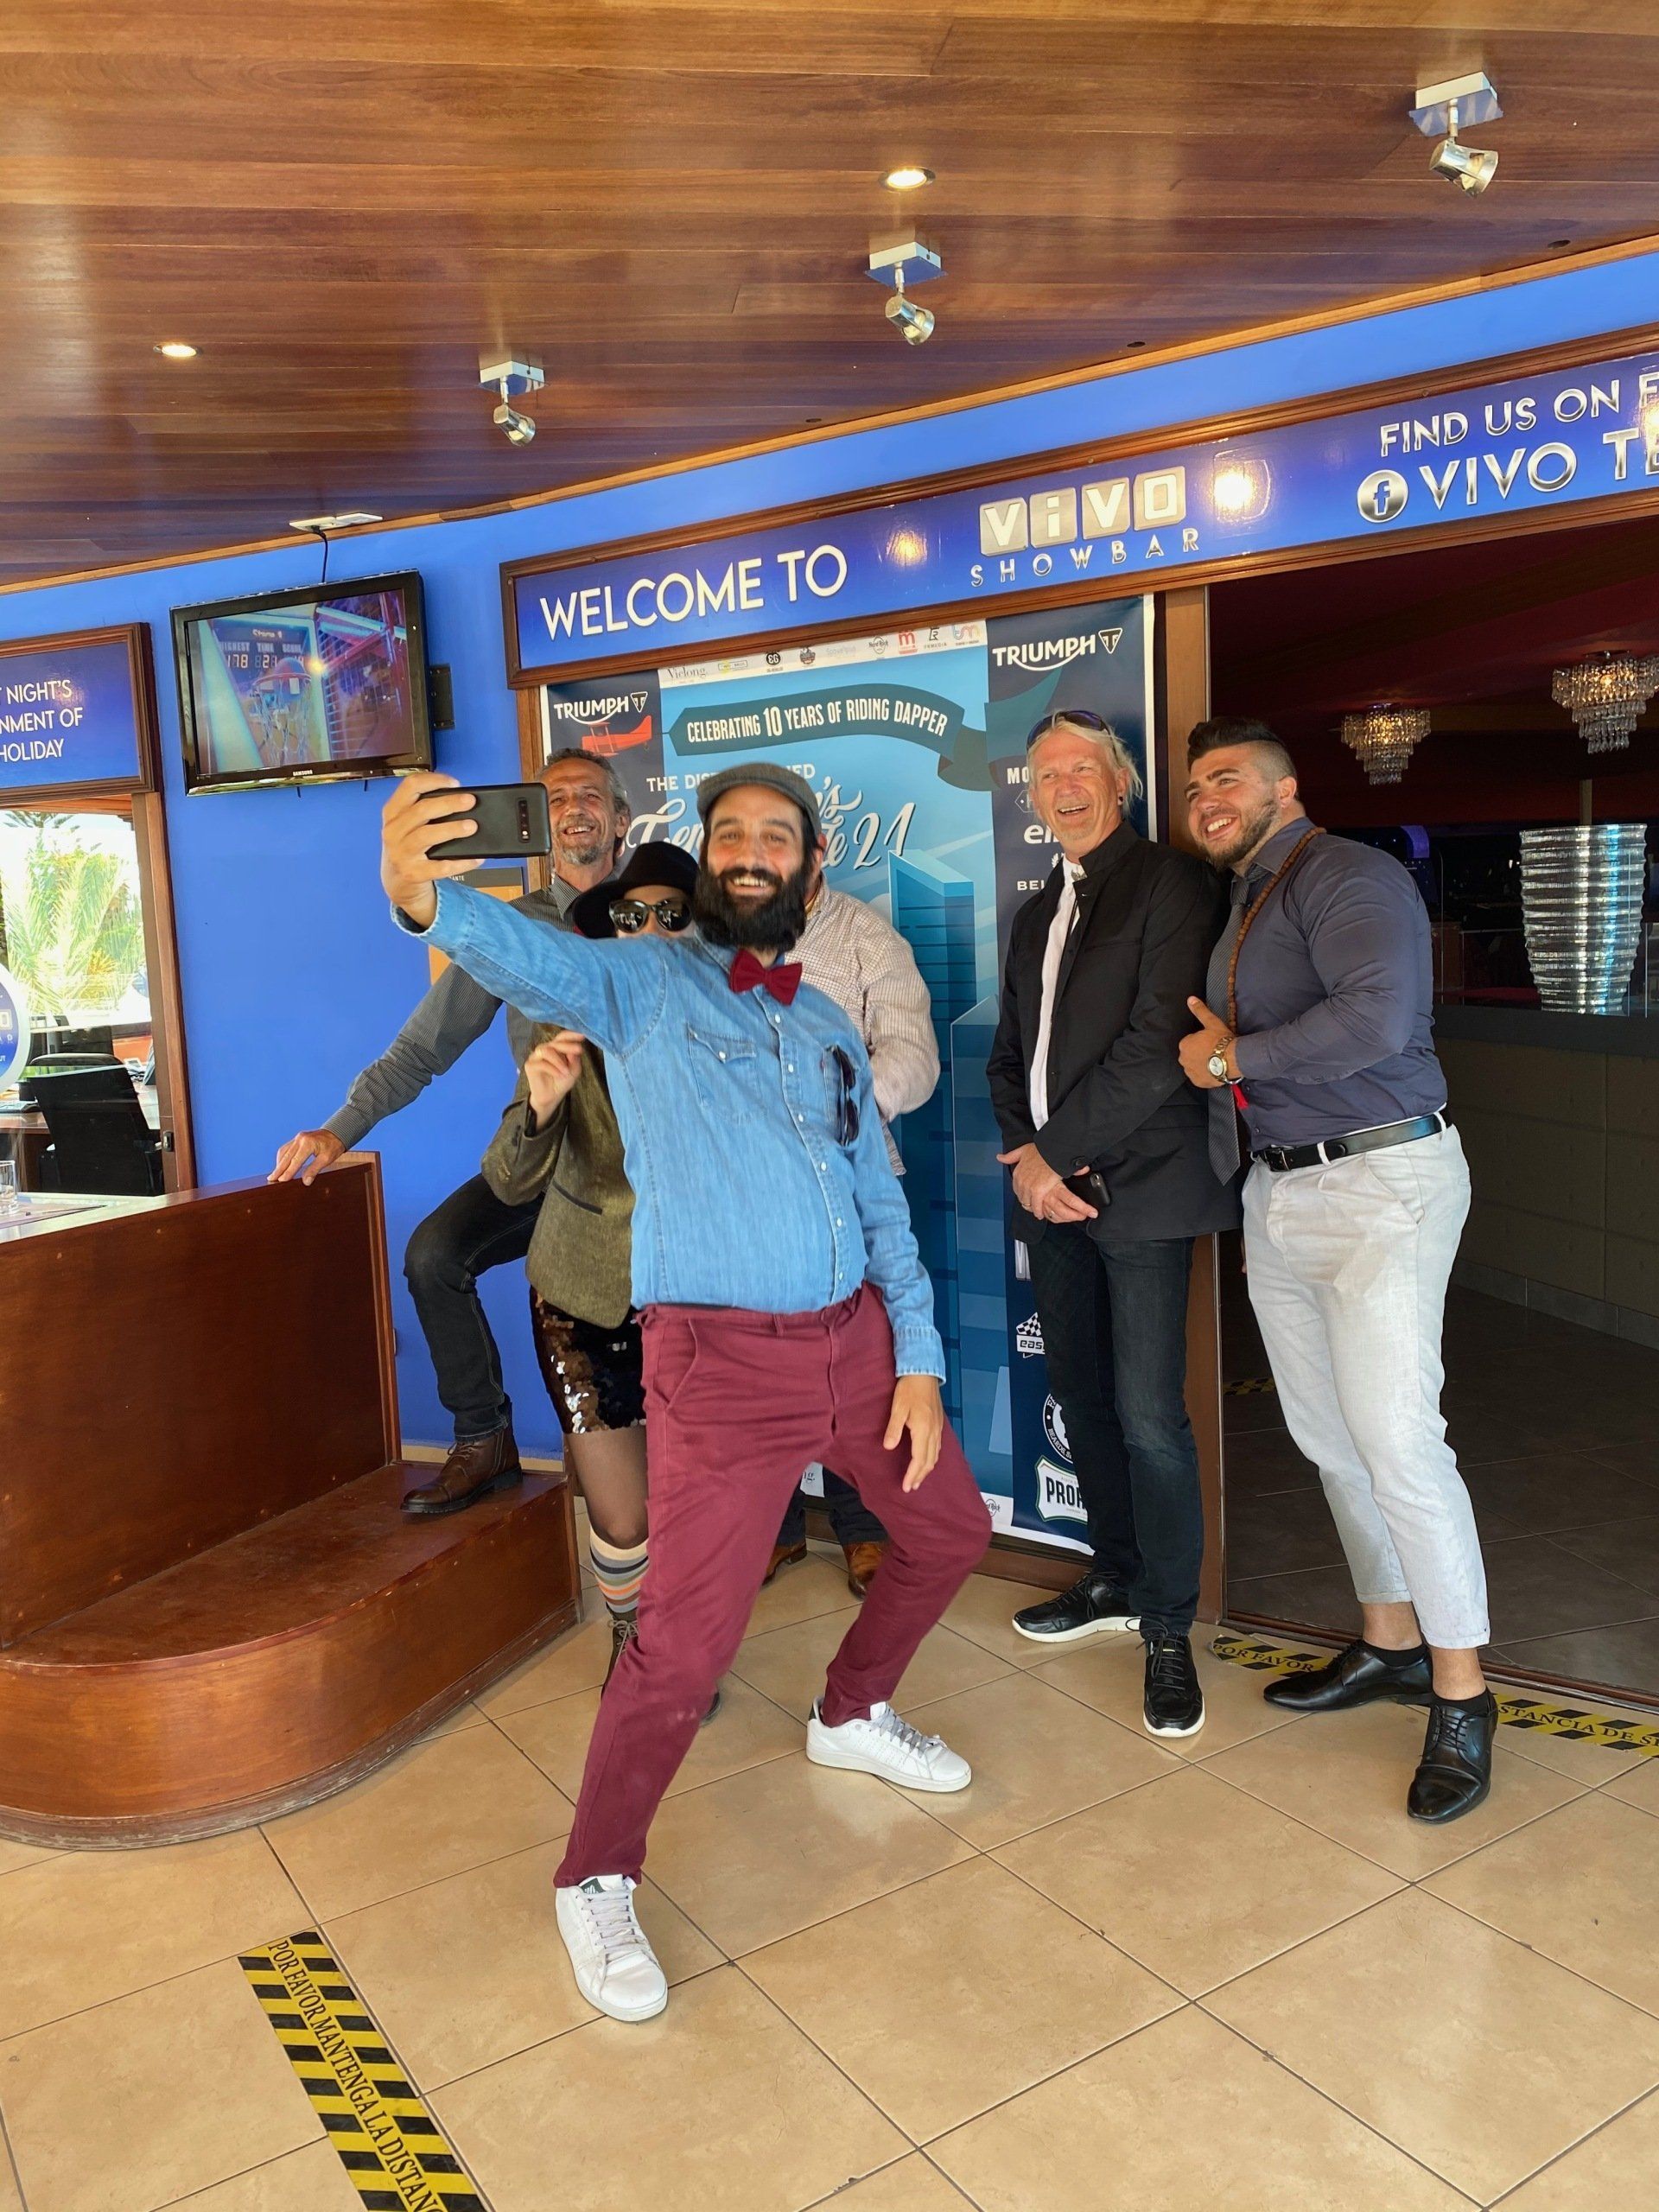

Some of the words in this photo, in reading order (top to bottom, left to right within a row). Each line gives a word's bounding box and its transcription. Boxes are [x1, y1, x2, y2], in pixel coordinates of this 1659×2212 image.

[1380, 411, 1469, 458] FIND
[1484, 397, 1537, 436] US
[1553, 379, 1620, 423] ON
[1418, 442, 1577, 511] VIVO
[970, 527, 1199, 588] SHOWBAR
[539, 557, 765, 641] WELCOME
[777, 544, 848, 602] TO
[992, 633, 1096, 671] TRIUMPH
[6, 679, 73, 705] NIGHT'S
[0, 709, 55, 734] NMENT
[59, 706, 84, 728] OF
[553, 696, 630, 725] TRIUMPH
[686, 715, 761, 743] CELEBRATING
[762, 706, 784, 737] 10
[783, 703, 825, 731] YEARS
[827, 701, 842, 724] OF
[846, 697, 890, 721] RIDING
[893, 700, 949, 737] DAPPER
[0, 738, 65, 763] HOLIDAY
[645, 775, 679, 792] THE
[853, 802, 917, 871] 21
[1020, 1339, 1044, 1351] eas
[1046, 1475, 1085, 1510] PROR
[1213, 1643, 1249, 1658] POR
[1252, 1652, 1314, 1673] FAVOR
[1497, 1705, 1596, 1734] STANCIA
[1602, 1727, 1635, 1742] DE
[267, 1939, 300, 1974] POR
[283, 1967, 327, 2022] FAVOR
[309, 2015, 379, 2117] MANTENGA
[362, 2110, 394, 2144] LA
